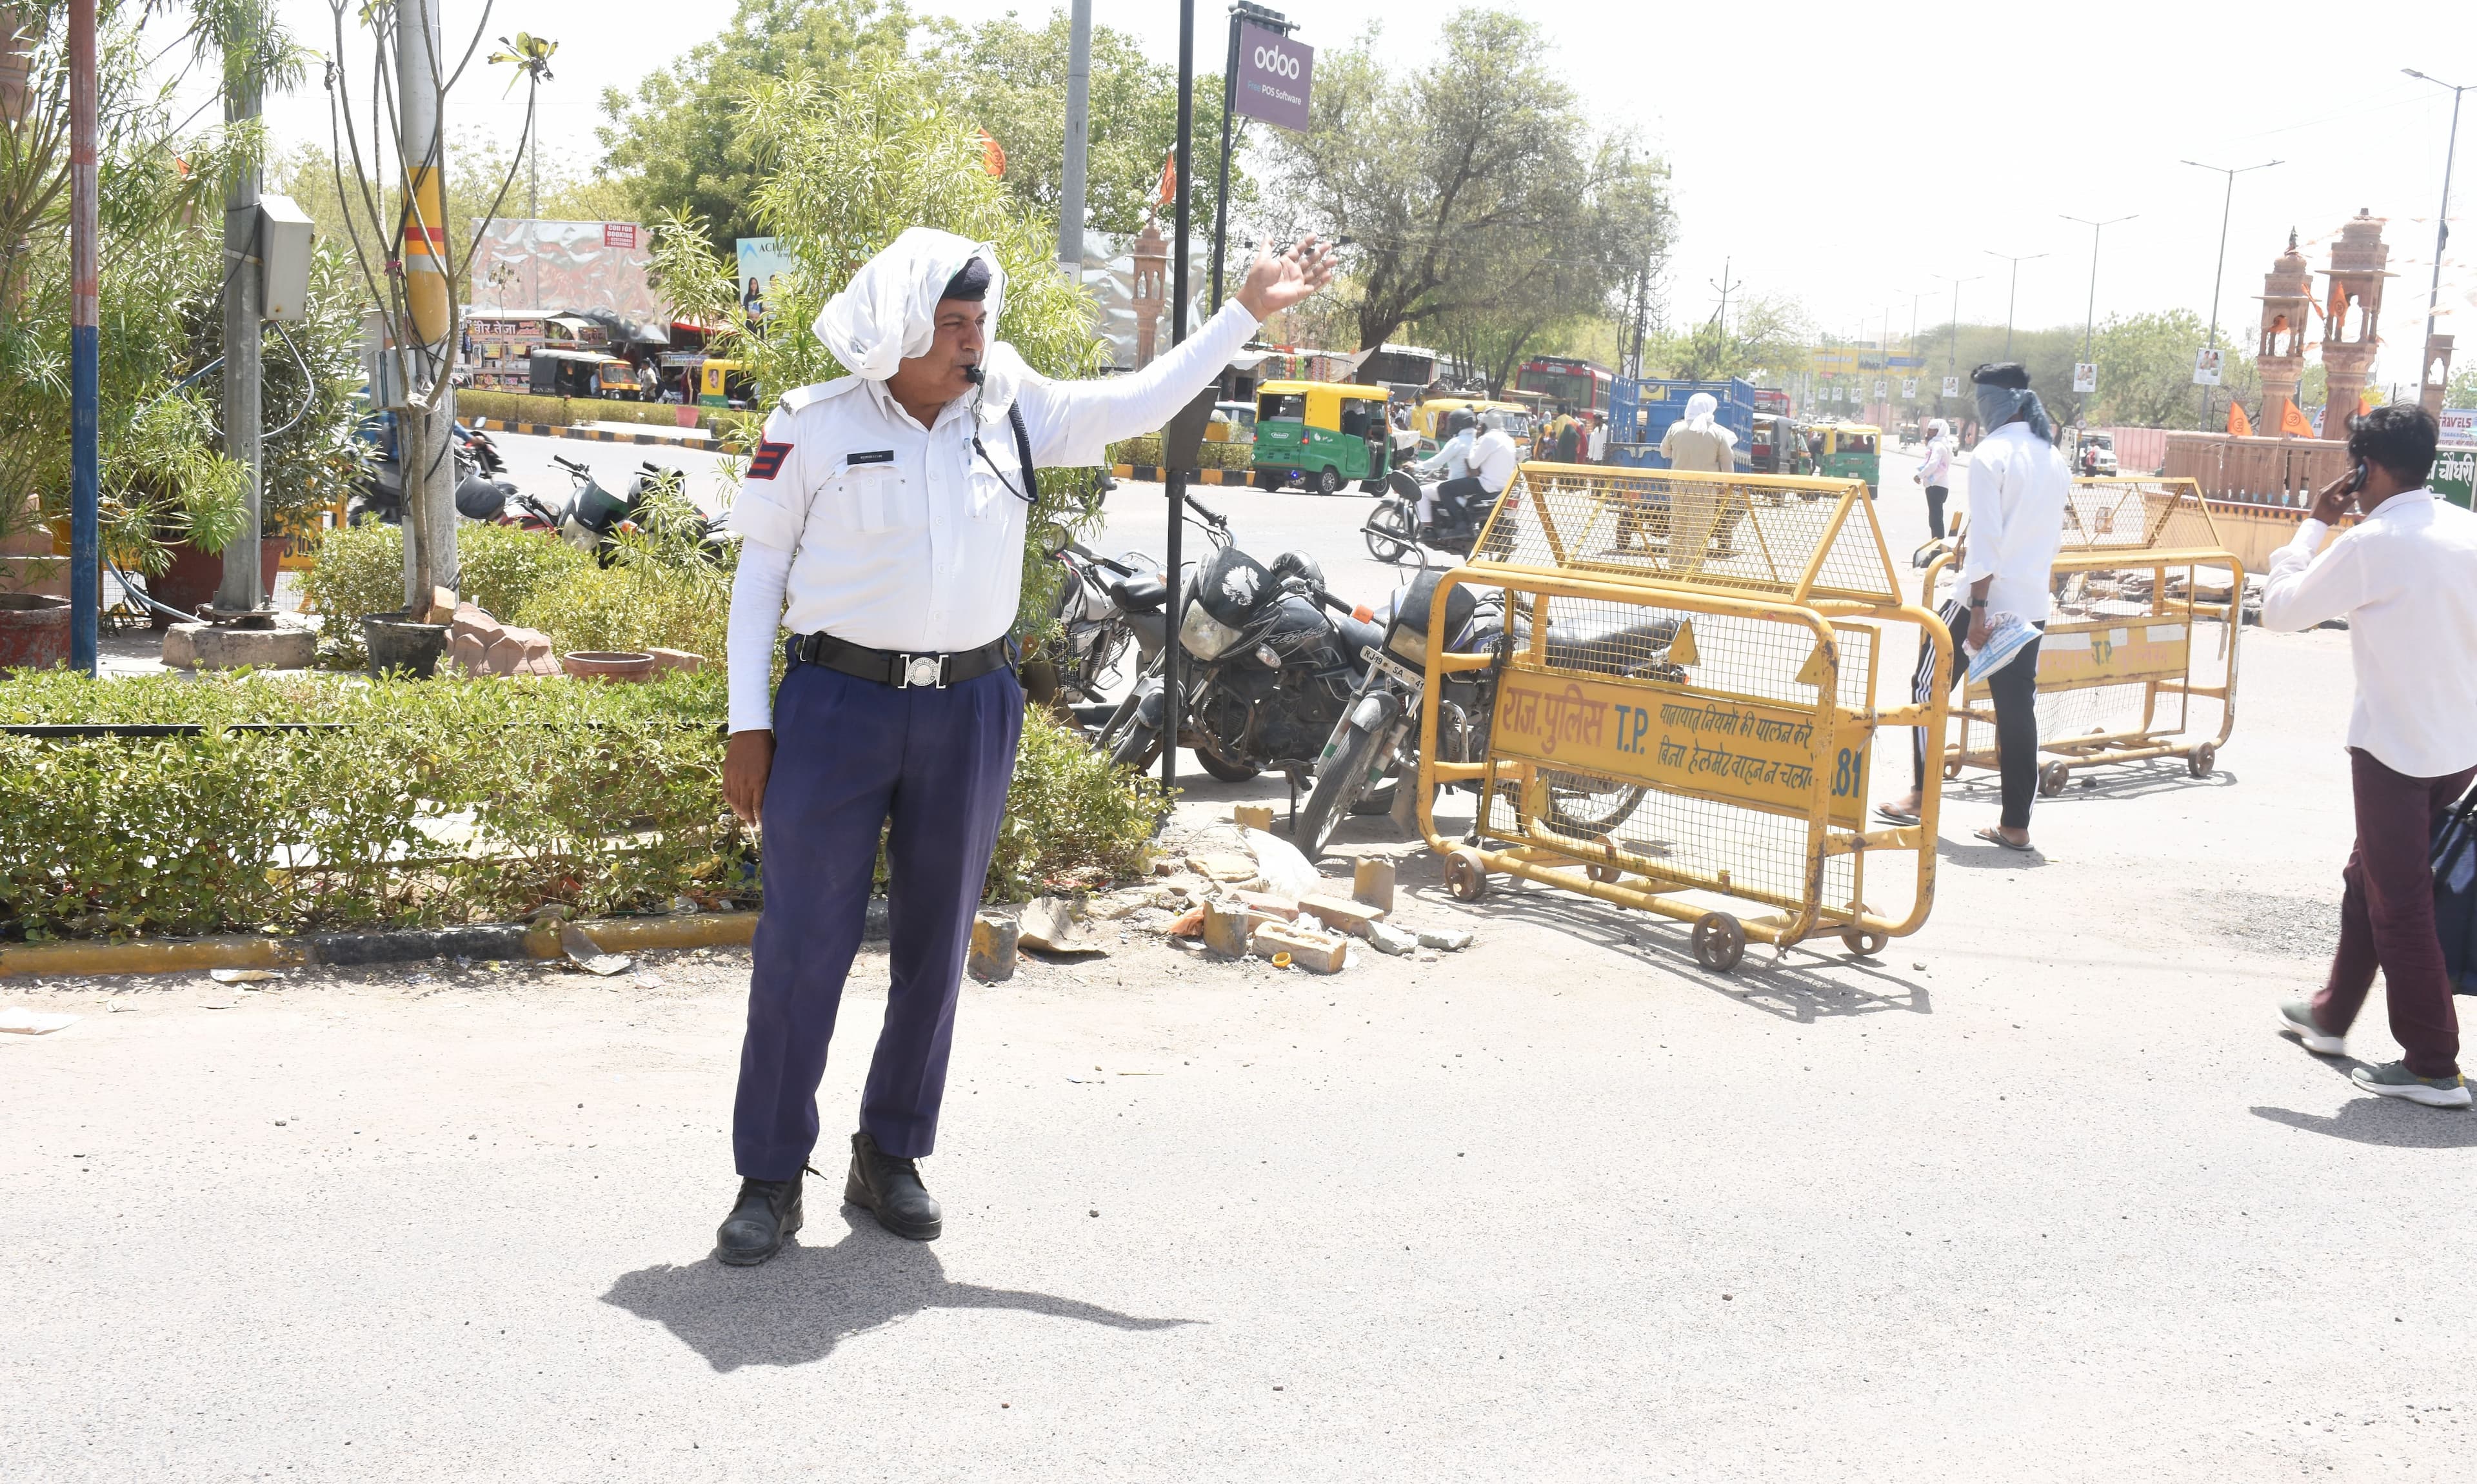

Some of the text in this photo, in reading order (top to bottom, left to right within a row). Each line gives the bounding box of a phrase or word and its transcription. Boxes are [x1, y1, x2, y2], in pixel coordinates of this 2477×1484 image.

[1254, 45, 1300, 80] odoo
[1262, 84, 1275, 97] POS
[1275, 89, 1302, 105] Software
[474, 320, 490, 334] वीर
[493, 321, 516, 335] तेजा
[1393, 667, 1404, 677] SA
[1415, 680, 1424, 690] 41
[1660, 703, 1704, 734] यातायात
[1701, 703, 1740, 735] नियमों
[1740, 711, 1756, 738] की
[1756, 718, 1795, 744] पालन
[1658, 734, 1688, 768] बिना
[1688, 738, 1733, 778] हेलमेट
[1731, 755, 1767, 785] वाहन
